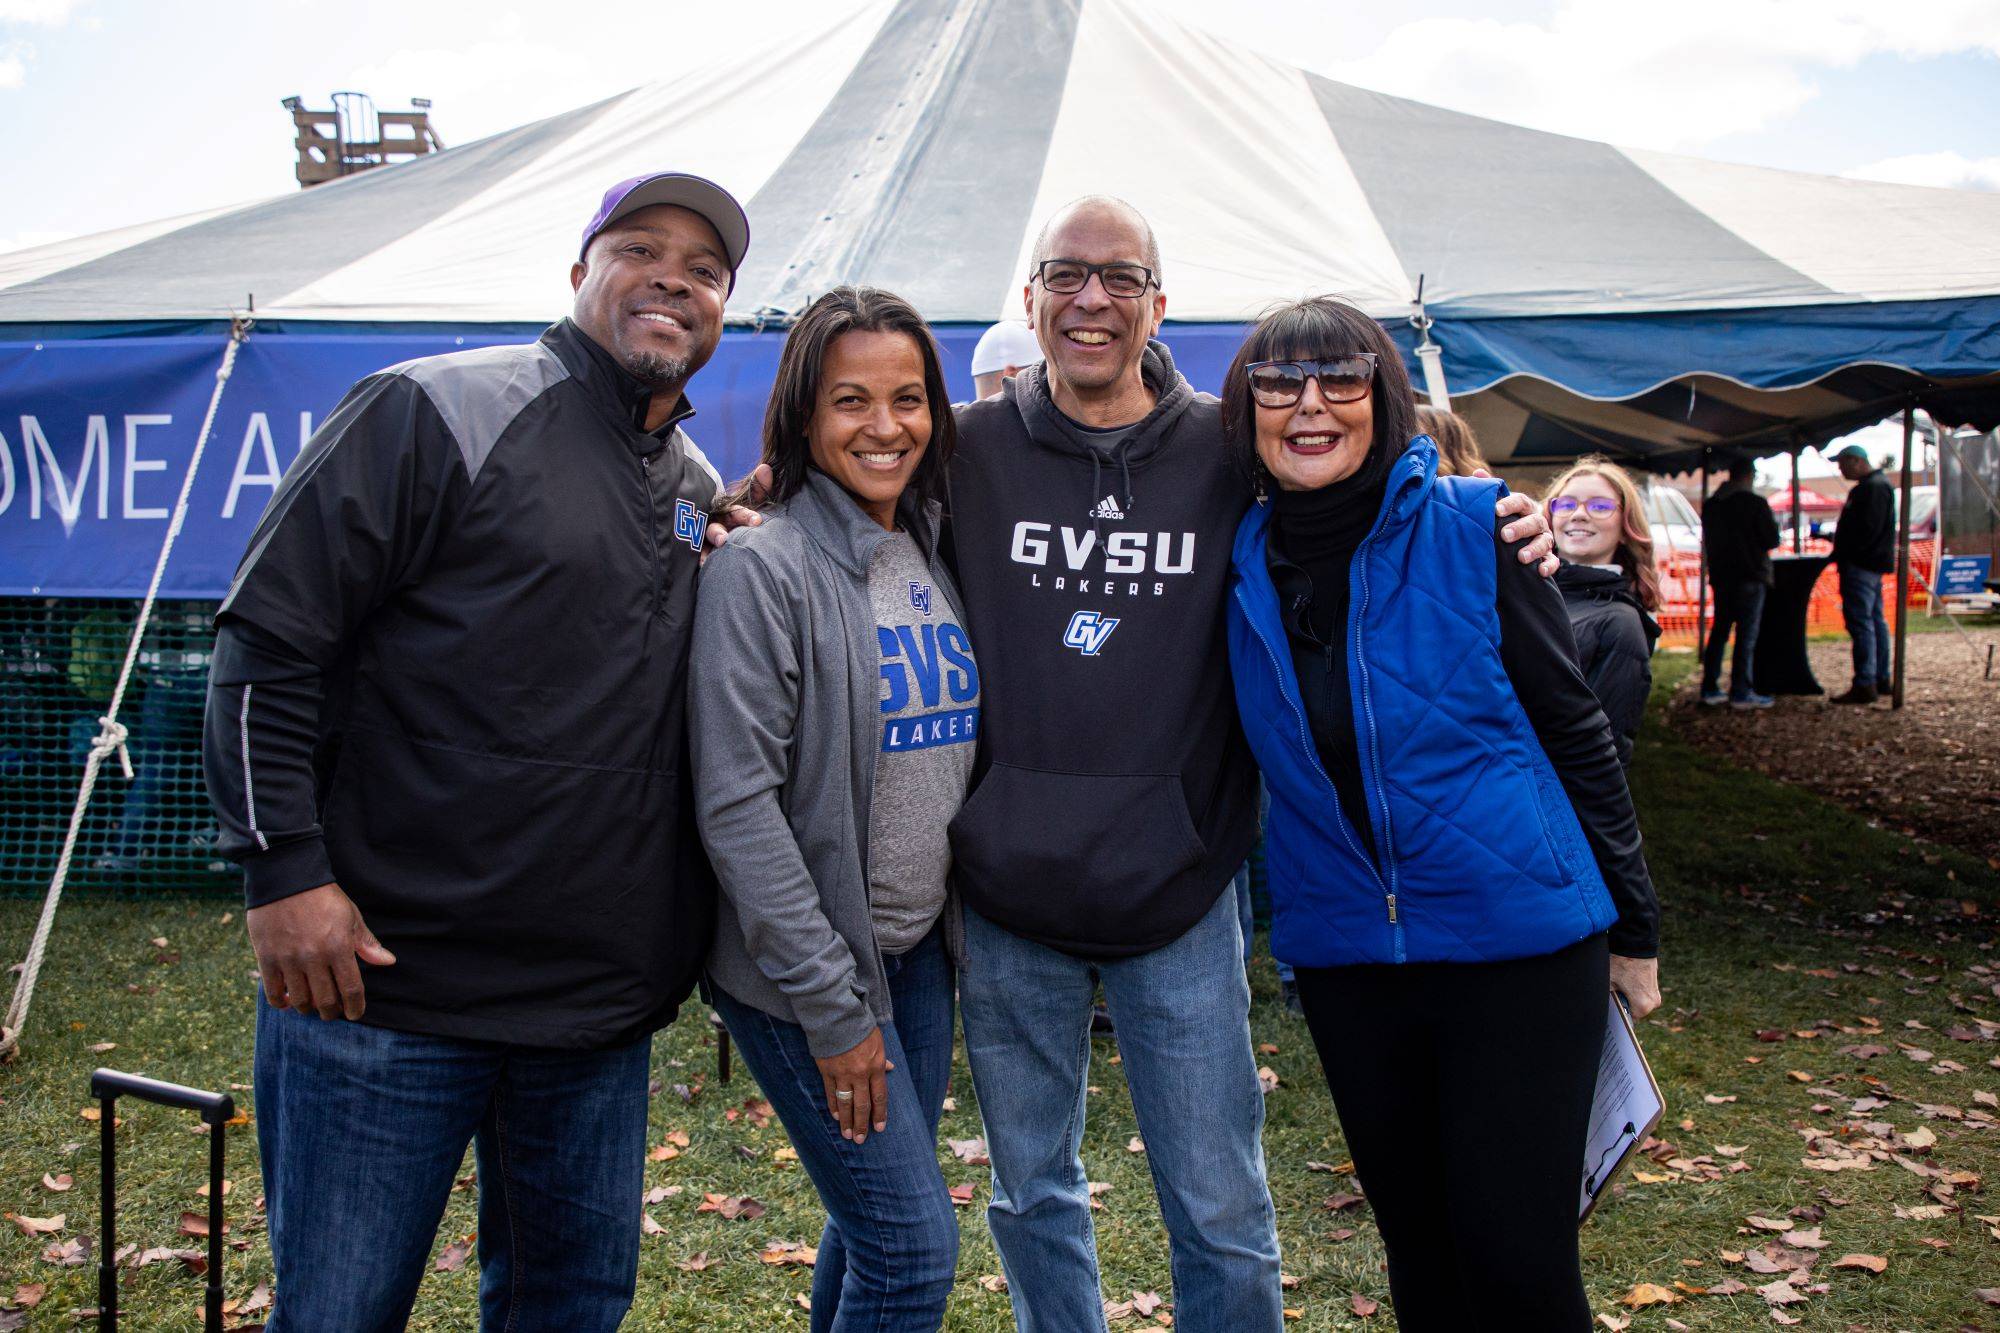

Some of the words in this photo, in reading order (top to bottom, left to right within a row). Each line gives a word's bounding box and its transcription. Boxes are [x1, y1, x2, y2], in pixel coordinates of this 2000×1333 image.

[674, 498, 708, 552] GV
[1011, 521, 1195, 574] GVSU
[908, 580, 932, 616] GV
[1032, 573, 1163, 596] LAKERS
[1063, 610, 1120, 655] GV
